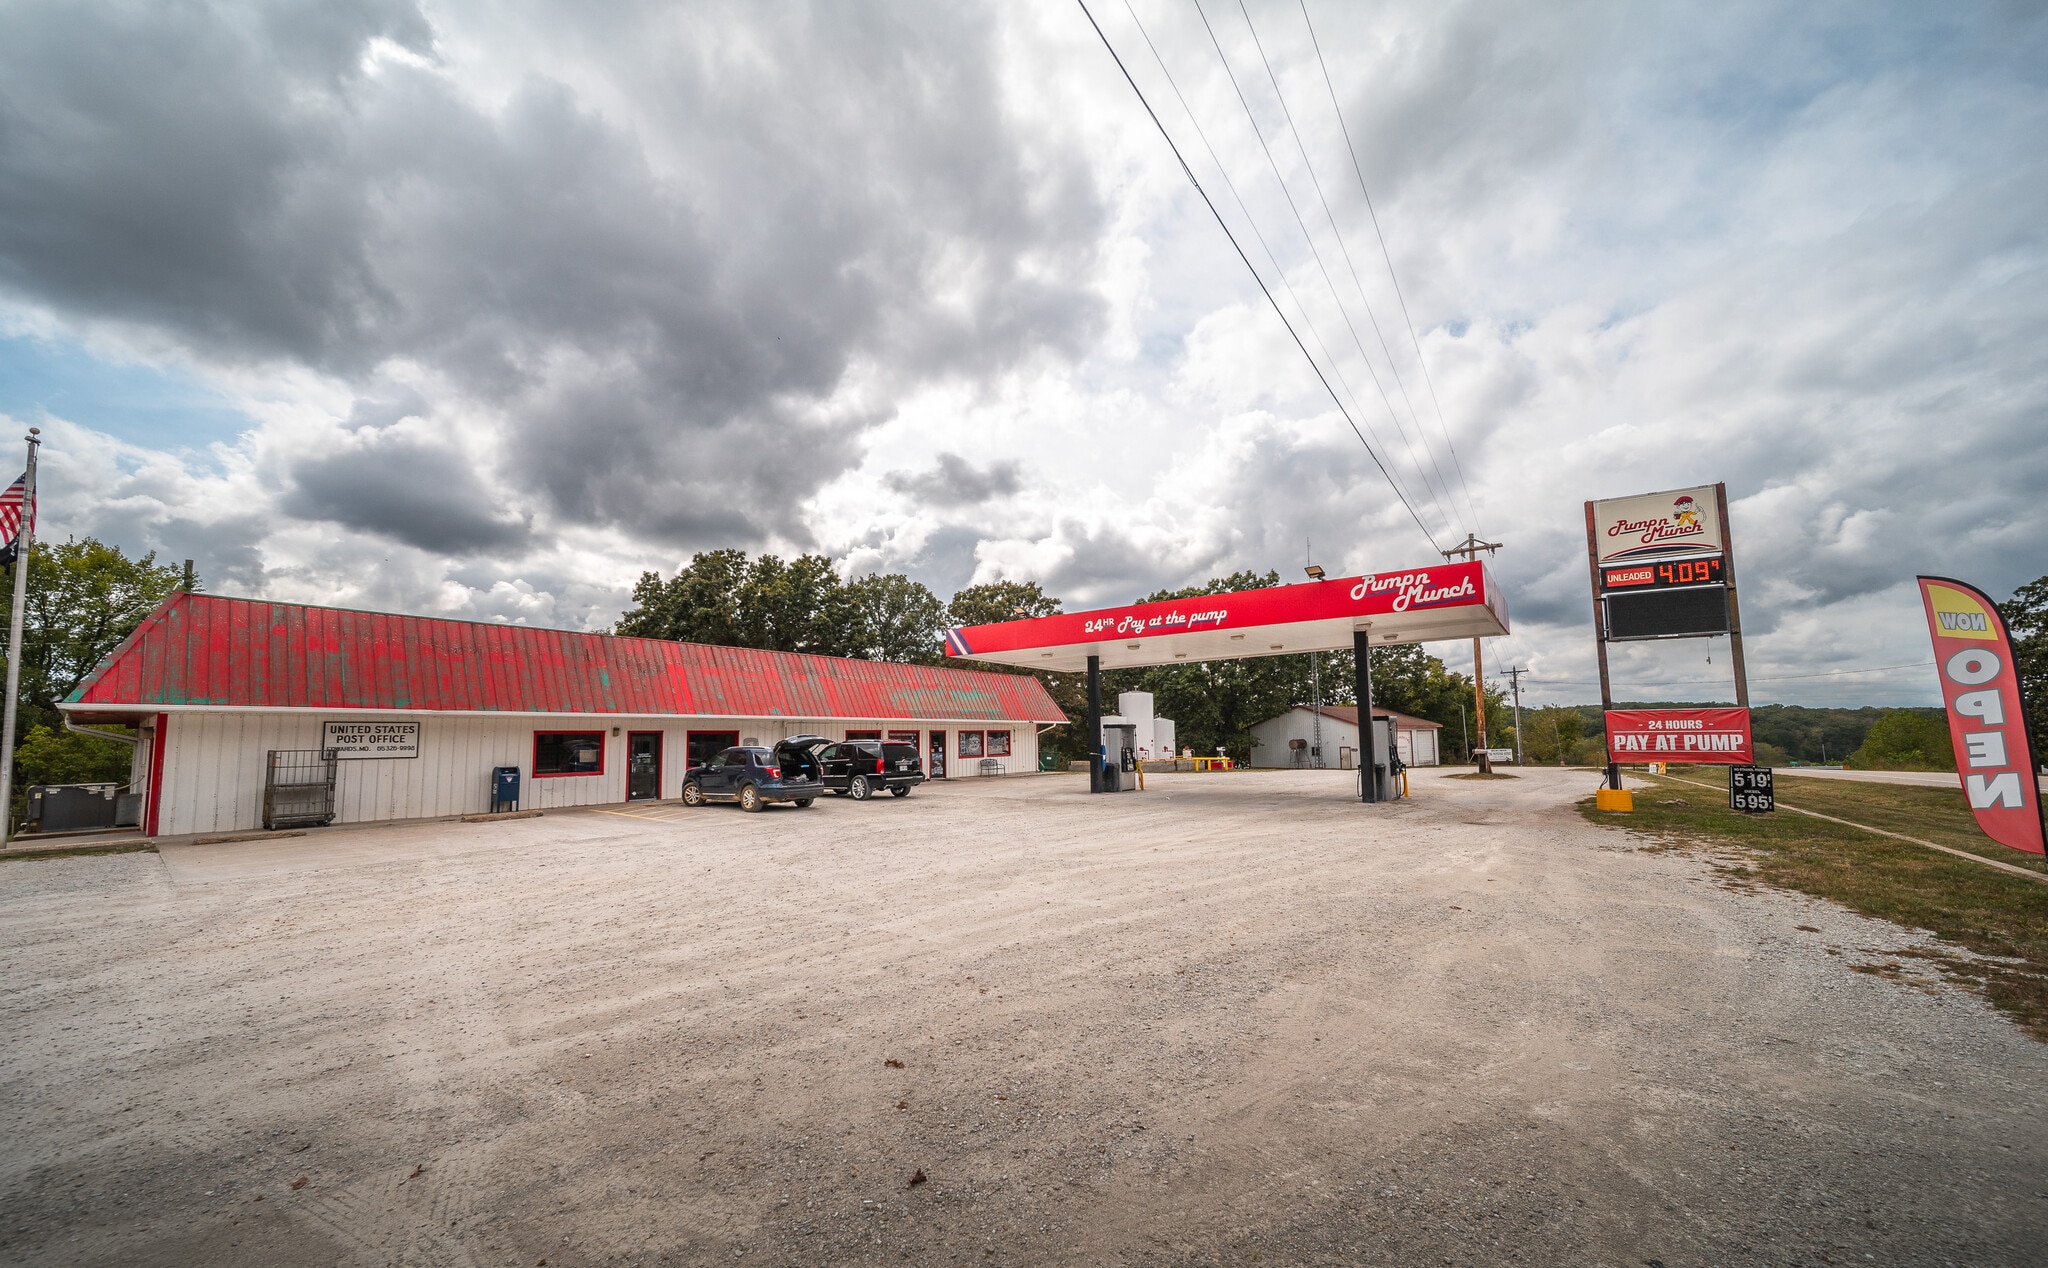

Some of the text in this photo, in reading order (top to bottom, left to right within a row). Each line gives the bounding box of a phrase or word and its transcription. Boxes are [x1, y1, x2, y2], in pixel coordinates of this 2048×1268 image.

[1641, 520, 1703, 543] Munch
[1607, 571, 1652, 583] UNLEADED
[1392, 575, 1476, 612] Munch
[1117, 616, 1145, 634] Pay
[1148, 615, 1162, 626] at
[1165, 610, 1186, 624] the
[1187, 610, 1227, 628] pump
[330, 725, 415, 734] UNITED STATES
[1648, 719, 1703, 730] 24 HOURS
[336, 735, 406, 743] POST OFFICE
[1614, 734, 1744, 750] PAY AT PUMP
